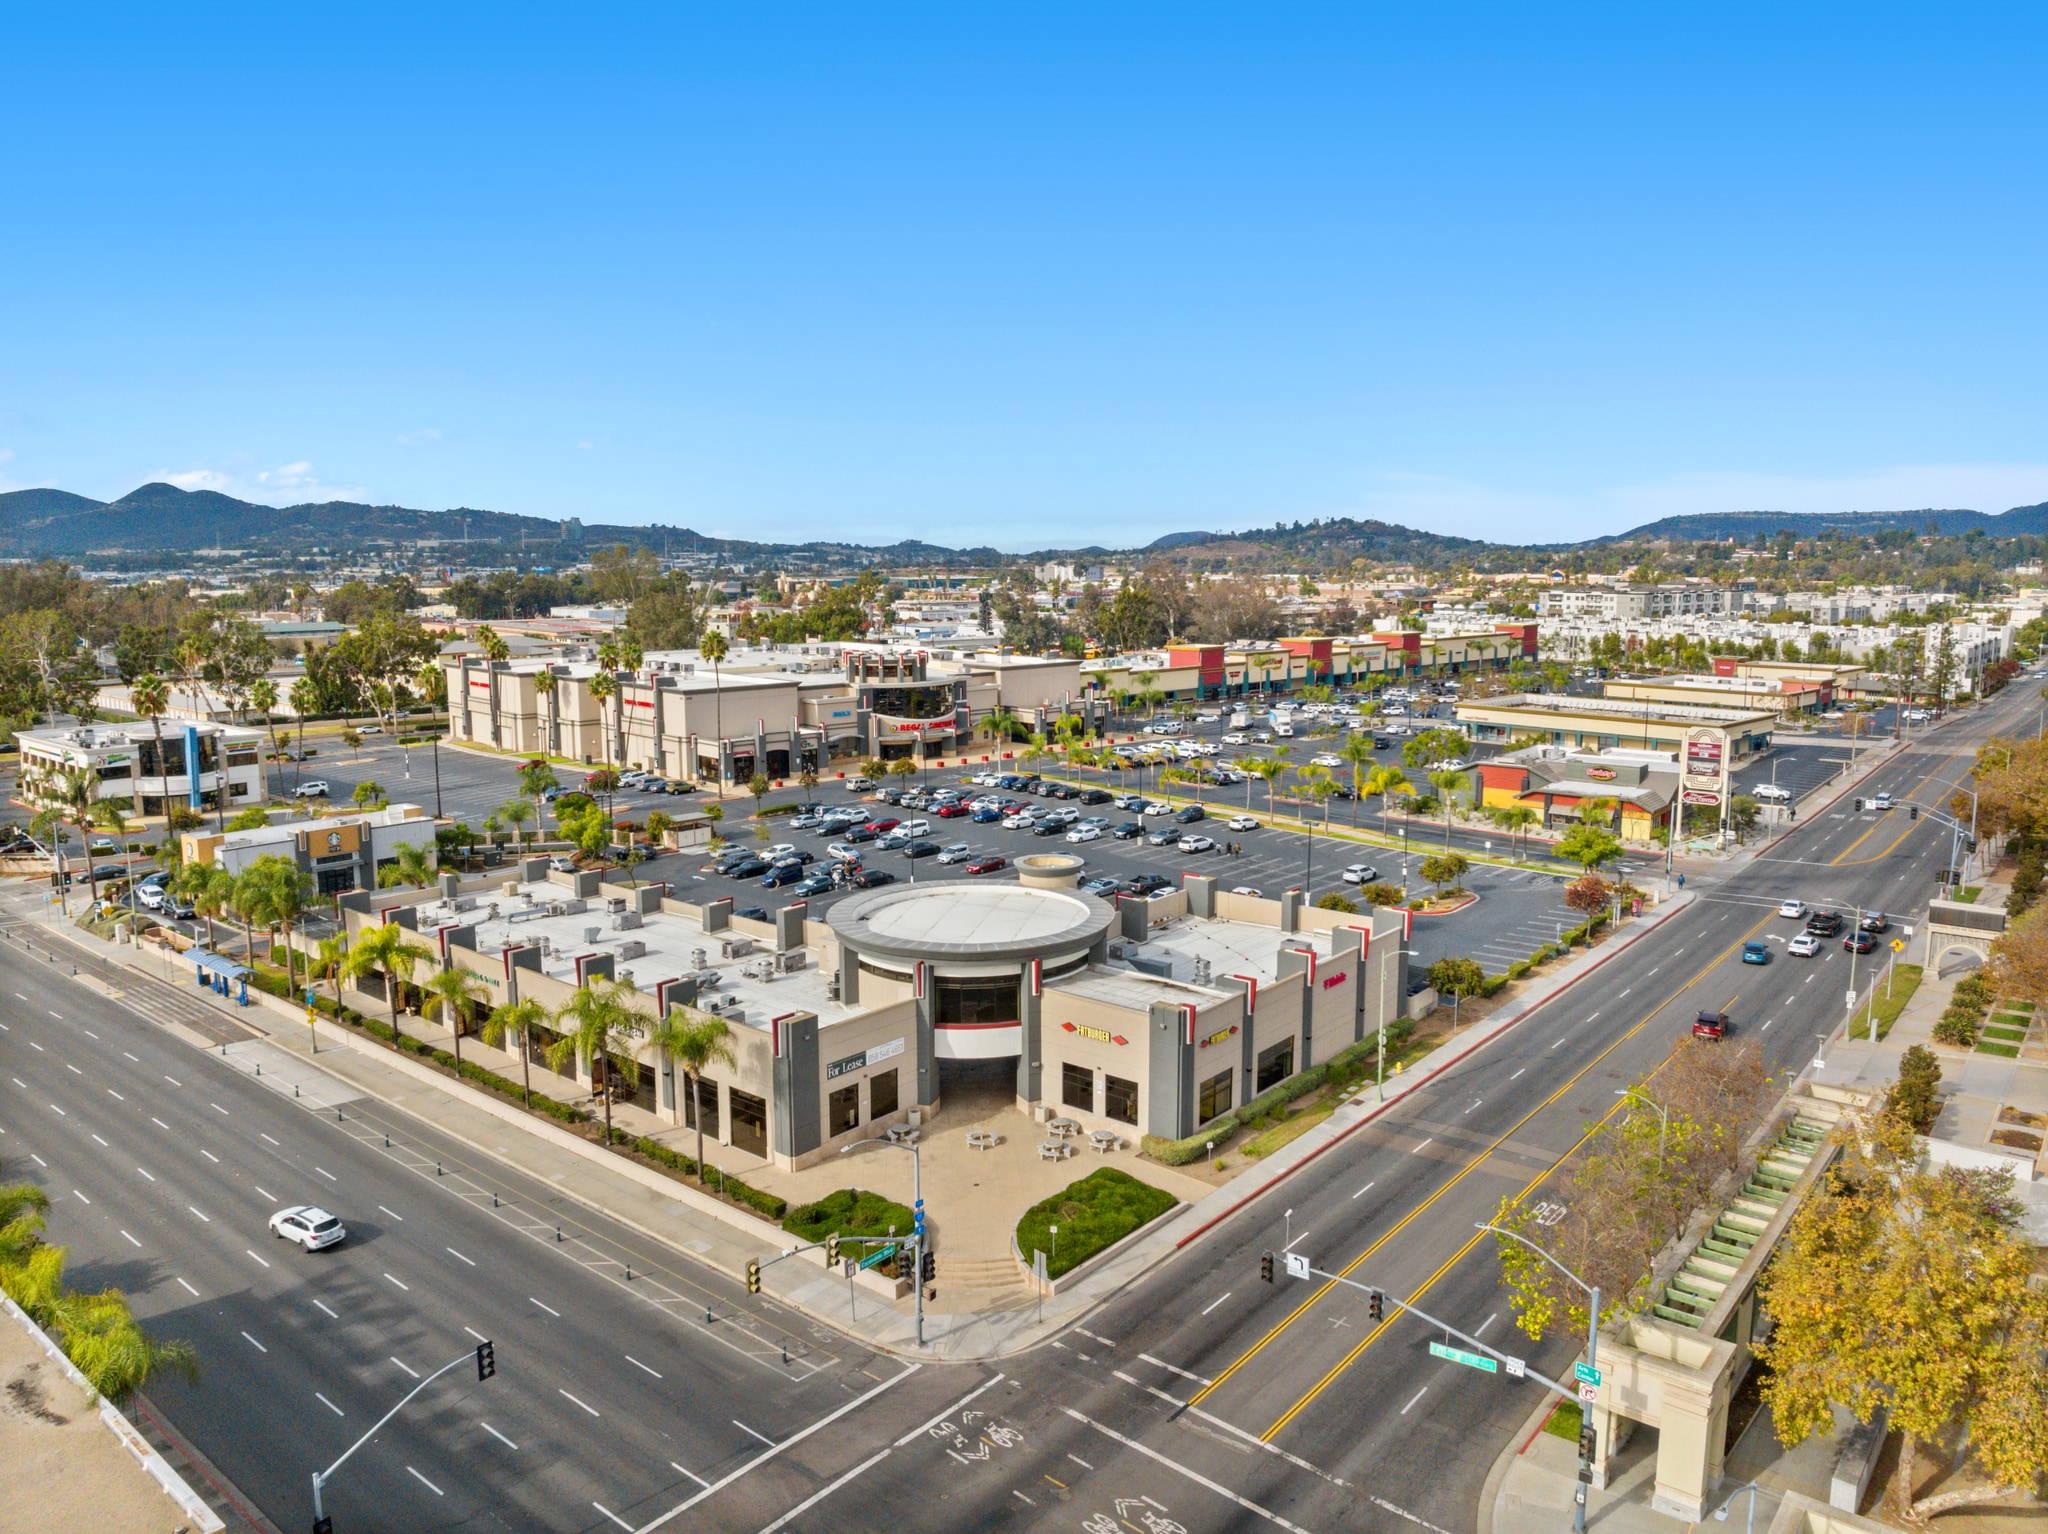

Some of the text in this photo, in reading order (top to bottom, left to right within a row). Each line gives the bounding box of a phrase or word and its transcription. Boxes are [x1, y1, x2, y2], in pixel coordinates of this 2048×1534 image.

[1077, 1024, 1111, 1043] FATBURGER
[828, 1058, 864, 1079] For Lease
[1525, 1201, 1567, 1226] PED
[1577, 1365, 1589, 1373] Arts
[1577, 1372, 1594, 1382] Center
